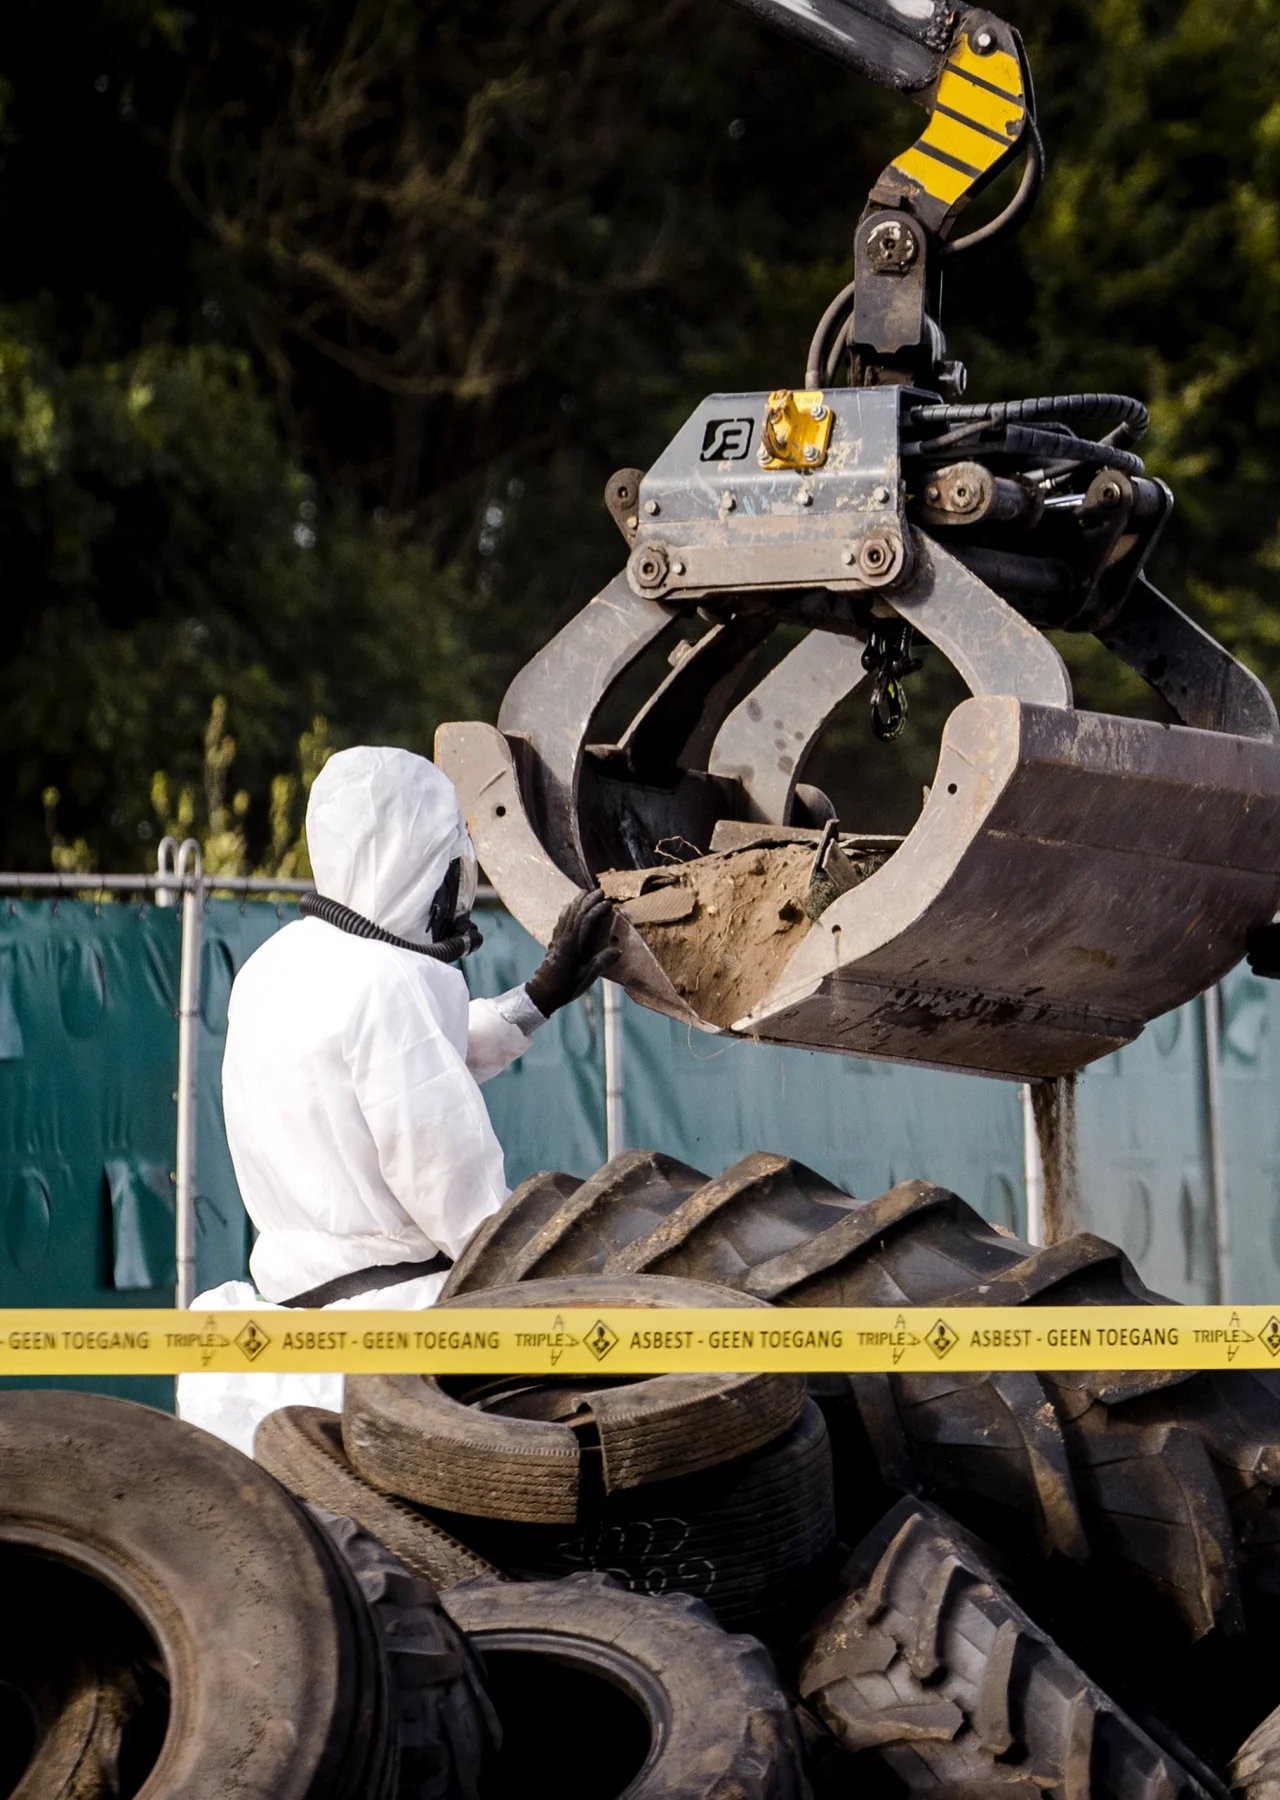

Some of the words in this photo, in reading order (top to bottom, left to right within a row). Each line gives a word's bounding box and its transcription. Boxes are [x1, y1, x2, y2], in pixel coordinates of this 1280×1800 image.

[8, 1331, 57, 1349] GEEN
[62, 1331, 149, 1350] TOEGANG
[282, 1330, 347, 1349] ASBEST
[363, 1331, 409, 1350] GEEN
[414, 1331, 500, 1350] TOEGANG
[629, 1330, 693, 1349] ASBEST
[708, 1330, 754, 1349] GEEN
[761, 1329, 843, 1349] TOEGANG
[970, 1328, 1032, 1347] ASBEST
[1047, 1328, 1091, 1347] GEEN
[1096, 1327, 1179, 1347] TOEGANG
